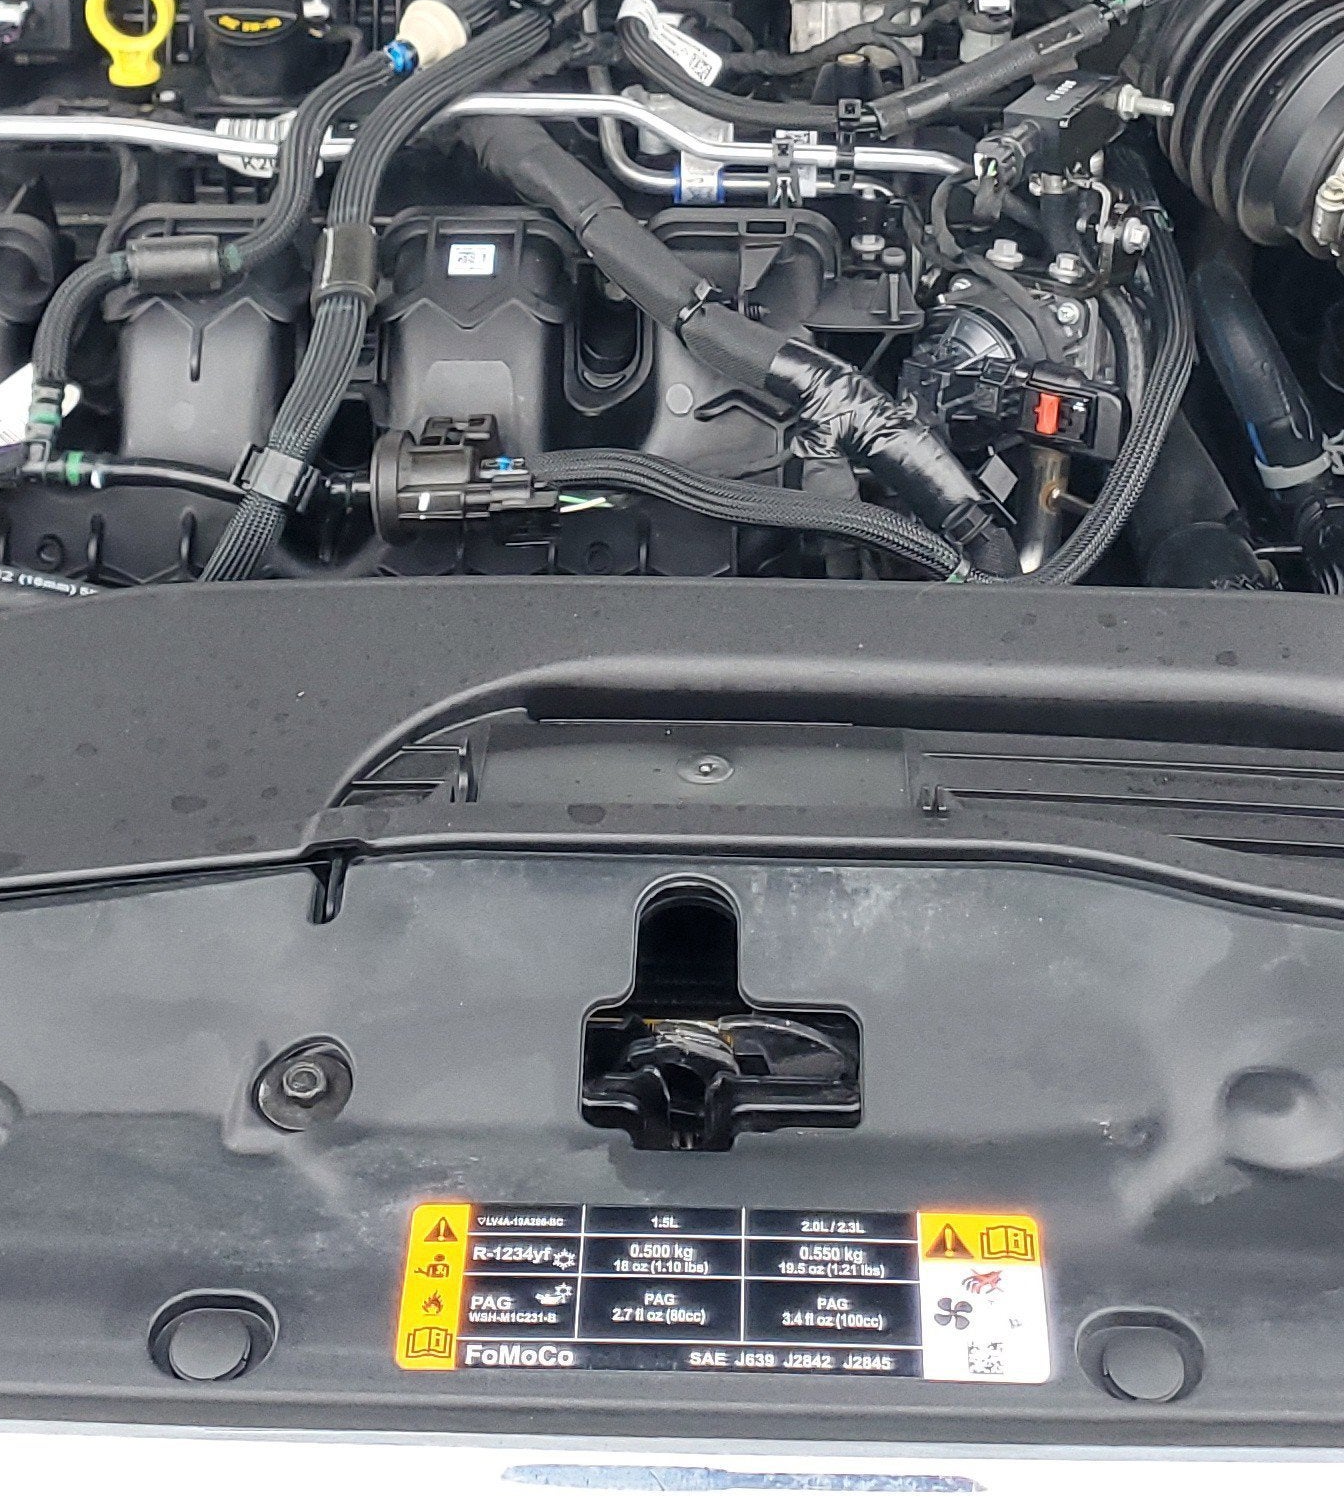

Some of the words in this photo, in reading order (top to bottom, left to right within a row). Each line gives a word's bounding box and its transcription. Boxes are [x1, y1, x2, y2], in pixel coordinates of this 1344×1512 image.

[650, 1216, 680, 1228] 1.5L
[801, 1221, 829, 1232] 2.0L
[837, 1222, 865, 1234] 2.3L
[473, 1246, 552, 1264] R-1234yf
[630, 1243, 671, 1258] 0.500
[674, 1243, 693, 1261] kg
[799, 1246, 840, 1261] 0.550
[844, 1246, 863, 1264] kg
[632, 1262, 649, 1272] oz
[650, 1260, 682, 1275] (1.10
[684, 1261, 709, 1275] lbs)
[778, 1262, 806, 1274] 19.5
[809, 1265, 825, 1275] oz
[827, 1263, 857, 1277] (1.21
[860, 1264, 885, 1278] lbs)
[470, 1295, 513, 1310] PAG
[644, 1292, 676, 1306] PAG
[817, 1297, 849, 1311] PAG
[611, 1307, 633, 1321] 2.7
[635, 1307, 645, 1321] fl
[646, 1311, 664, 1321] oz
[782, 1311, 803, 1326] 3.4
[805, 1312, 814, 1326] fl
[816, 1316, 835, 1326] oz
[836, 1313, 884, 1330] (100cc)
[465, 1344, 575, 1367] FoMoCo
[689, 1351, 727, 1366] SAE
[734, 1352, 775, 1367] J639
[783, 1353, 833, 1369] J2842
[843, 1355, 892, 1370] J2845
